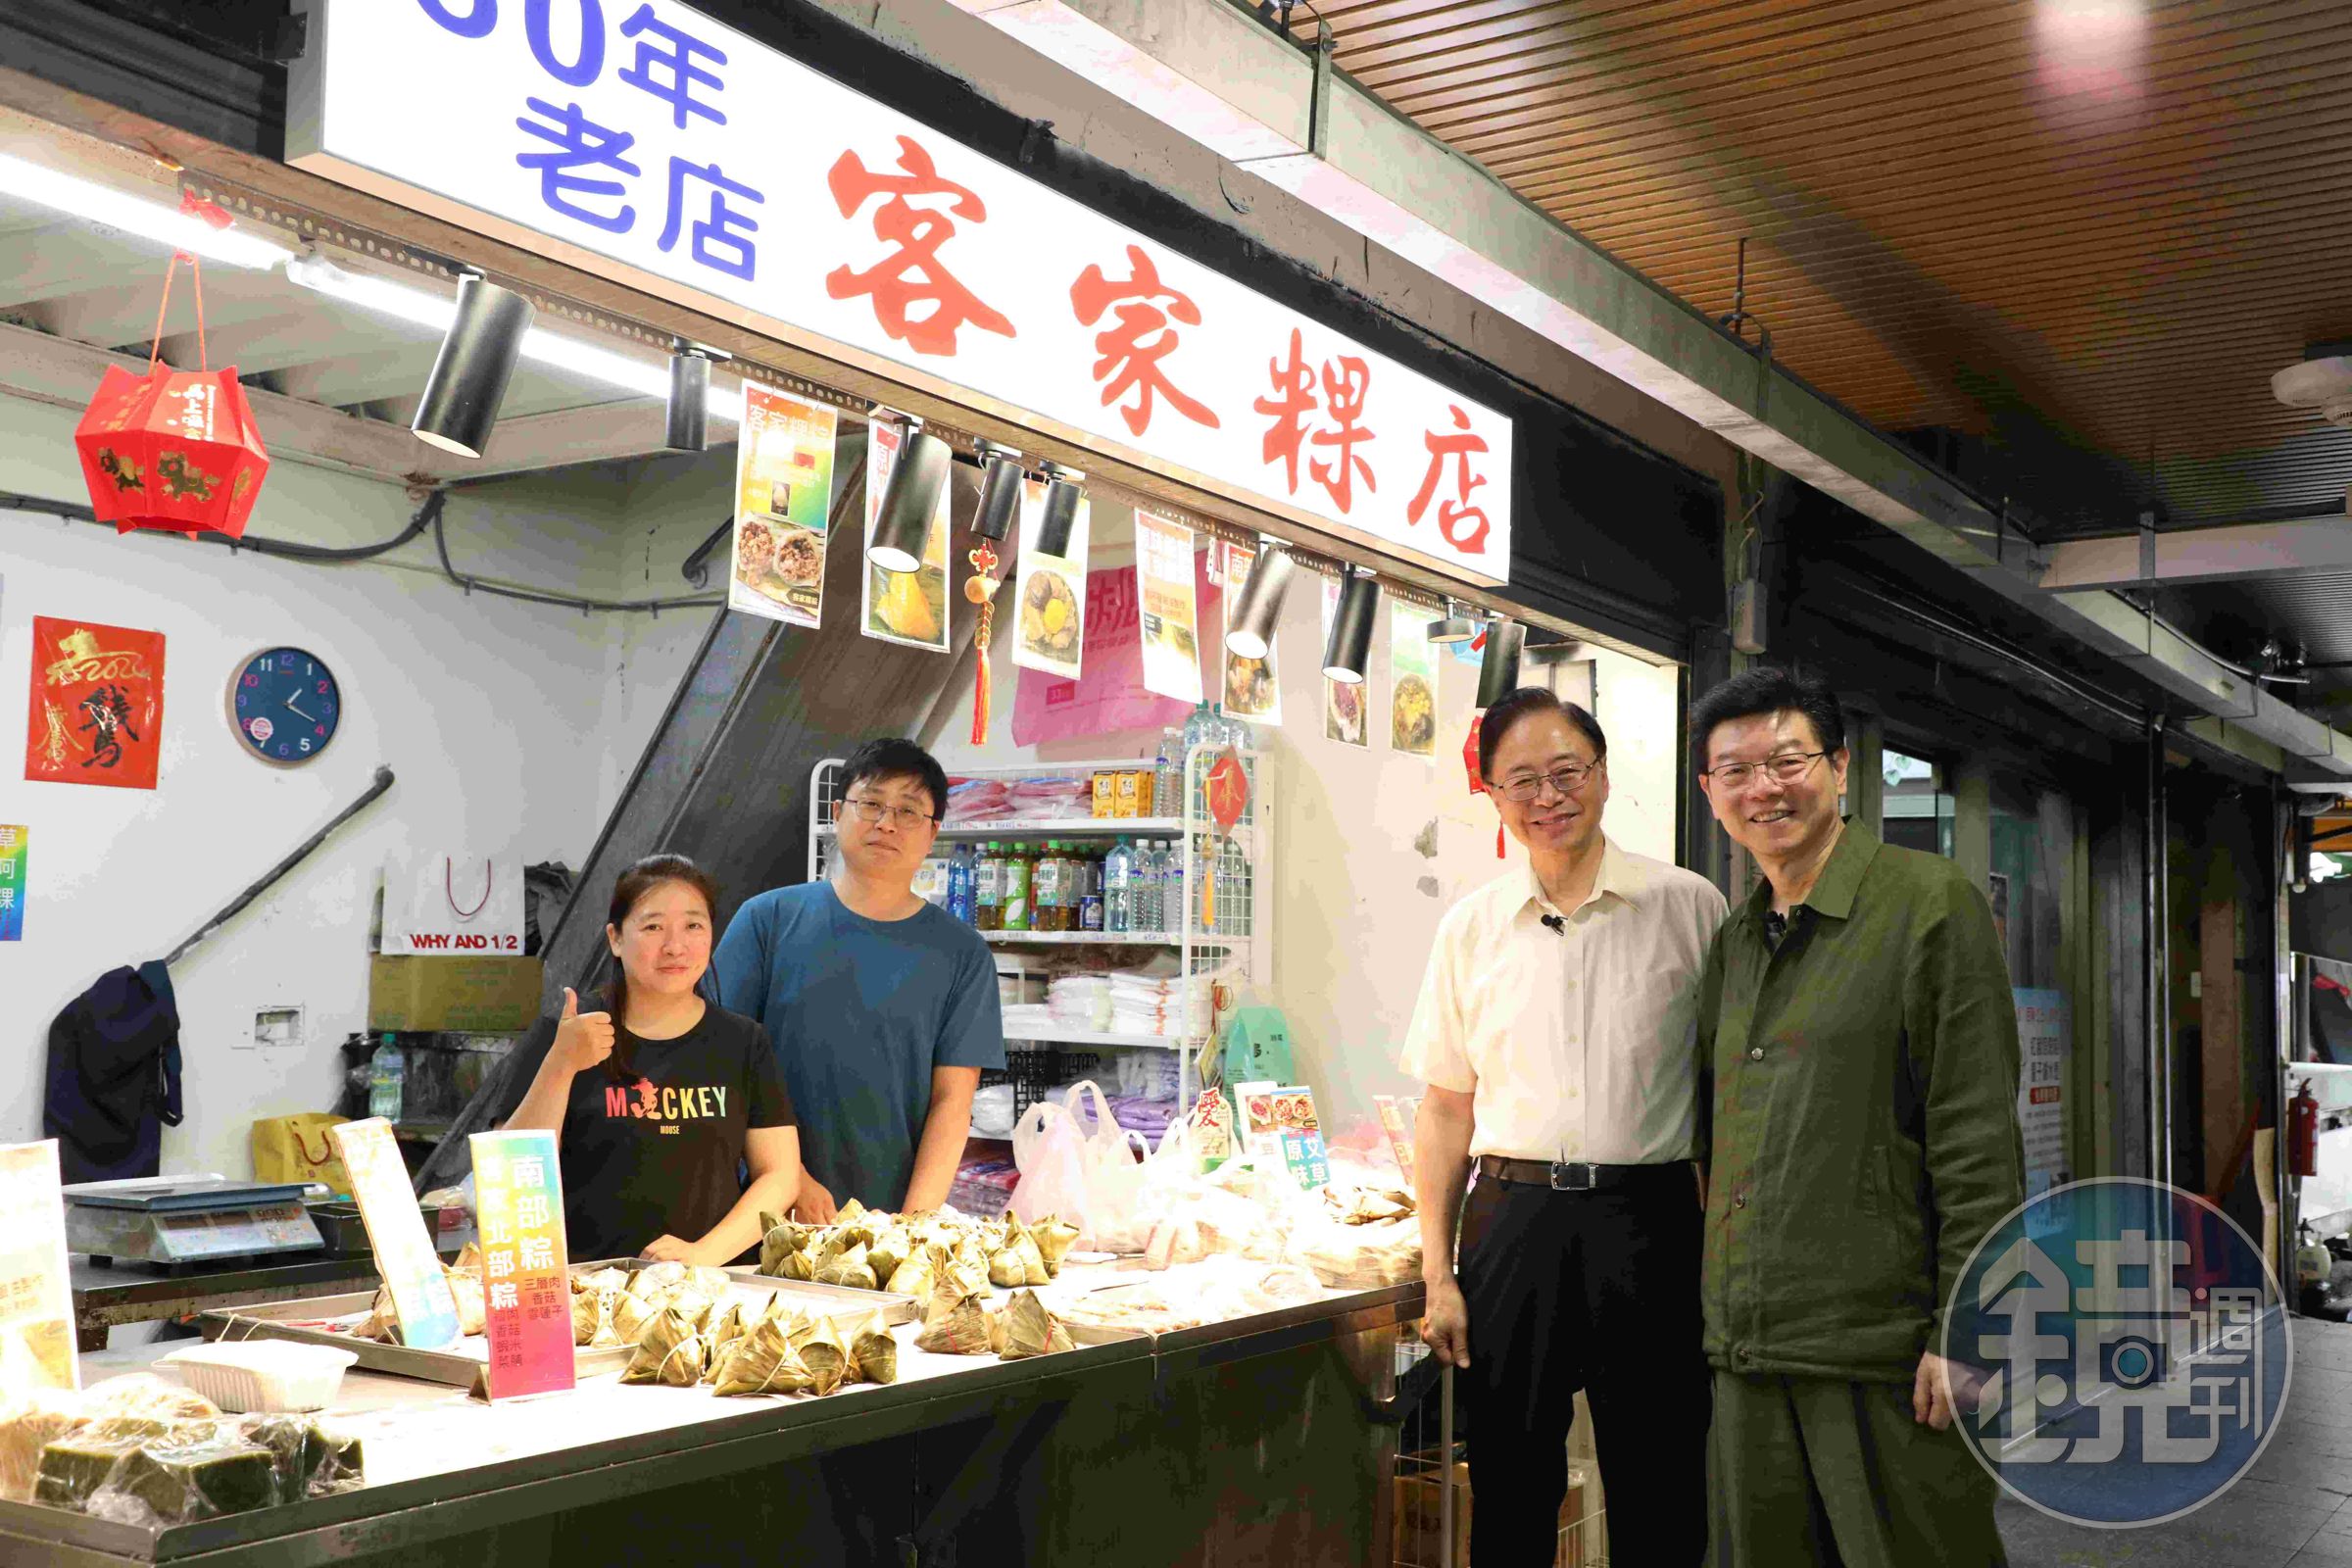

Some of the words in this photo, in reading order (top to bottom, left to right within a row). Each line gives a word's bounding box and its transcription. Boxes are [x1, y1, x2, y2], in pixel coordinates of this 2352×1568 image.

[514, 96, 765, 282] 老店
[826, 133, 1492, 557] 客家粿店
[260, 658, 272, 672] 11
[307, 662, 313, 676] 1
[318, 679, 329, 695] 2
[236, 694, 248, 708] 9
[314, 723, 325, 738] 4
[278, 743, 290, 757] 6
[299, 737, 312, 752] 5
[410, 933, 451, 950] WHY
[454, 934, 487, 950] AND
[491, 933, 518, 951] 1/2
[605, 1078, 727, 1120] MCKEY
[660, 1125, 680, 1135] MOUSE
[511, 1155, 556, 1272] 南部粽
[524, 1276, 561, 1291] 三層肉
[532, 1291, 557, 1306] 香菇
[496, 1323, 521, 1338] 香菇
